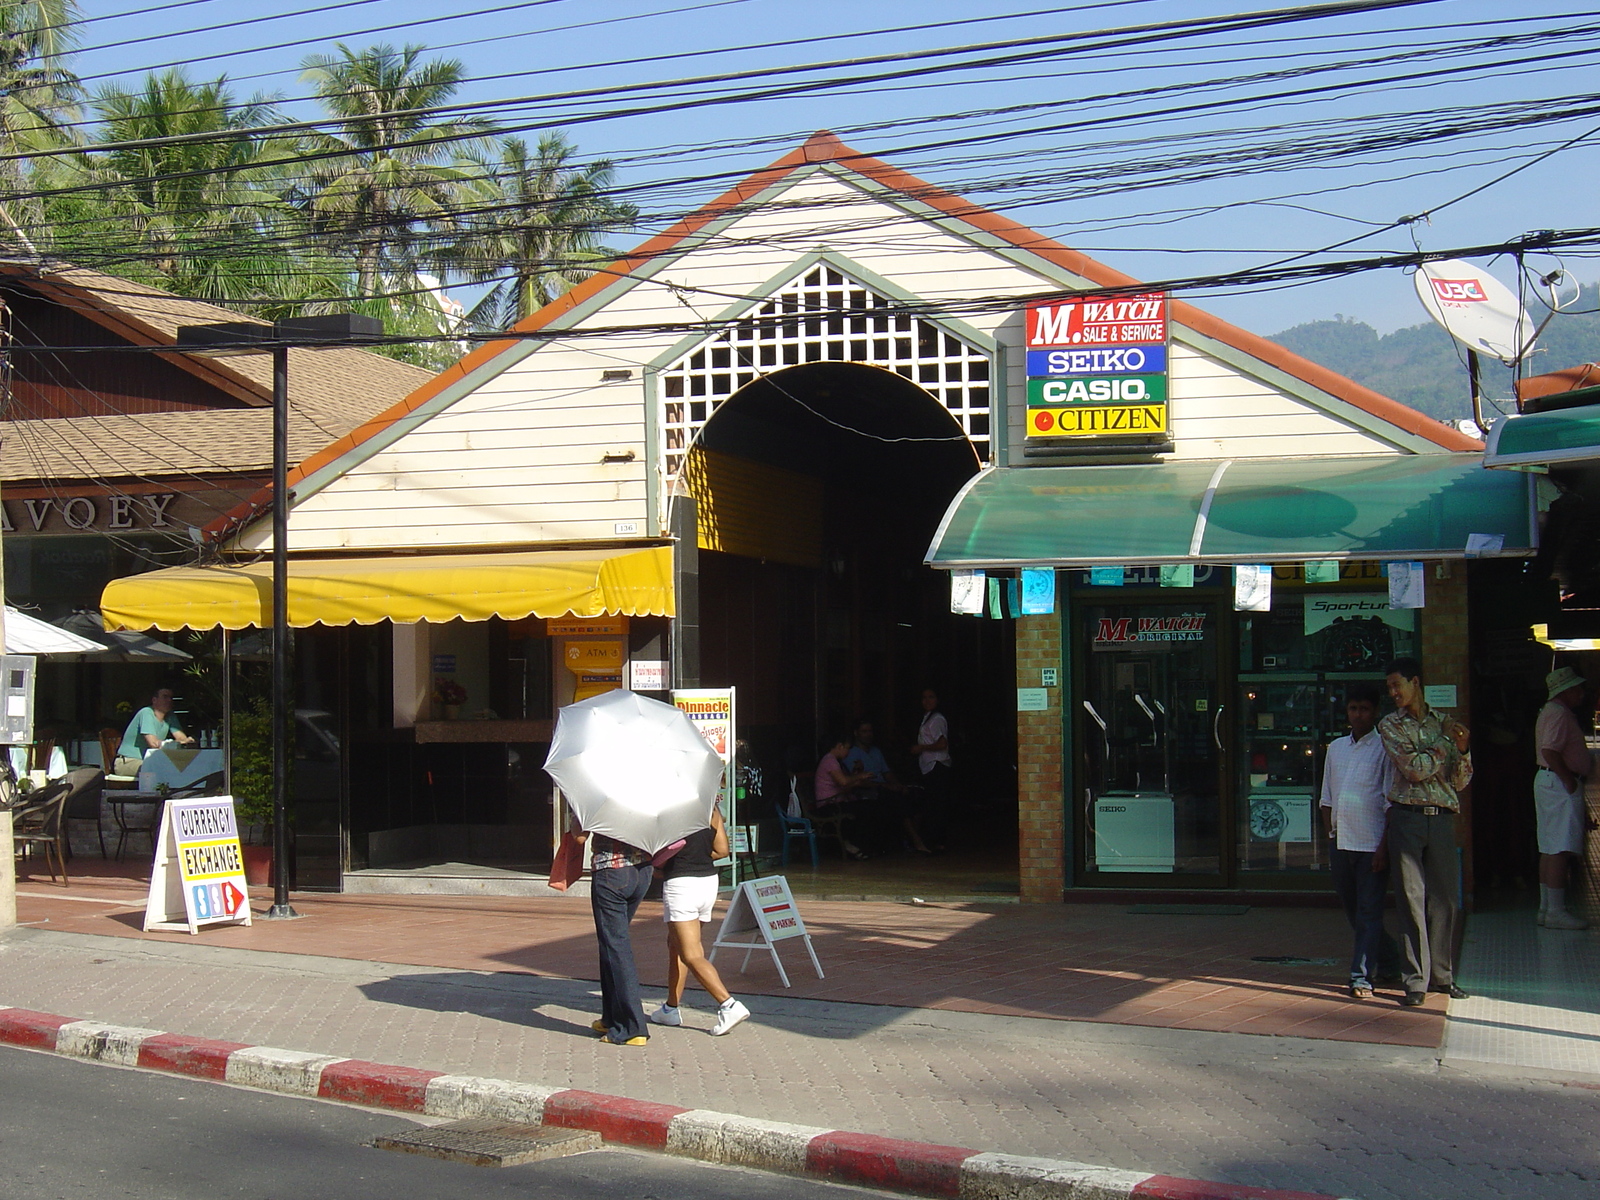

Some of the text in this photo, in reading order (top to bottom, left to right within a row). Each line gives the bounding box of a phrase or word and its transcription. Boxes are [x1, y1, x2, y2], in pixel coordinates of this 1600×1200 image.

[1435, 282, 1483, 299] UBC
[1031, 300, 1162, 345] M. WATCH
[1083, 324, 1162, 343] SALE & SERVICE
[1048, 348, 1145, 373] SEIKO
[1043, 379, 1145, 402] CASIO
[1058, 407, 1163, 431] CITIZEN
[1094, 617, 1205, 642] M. WATCH
[1137, 633, 1203, 641] ORIGINAL
[586, 649, 607, 657] ATM
[1098, 805, 1126, 813] SEIKO
[181, 807, 231, 837] CURRENCY
[185, 844, 241, 875] EXCHANGE
[769, 917, 797, 930] NO PARKING
